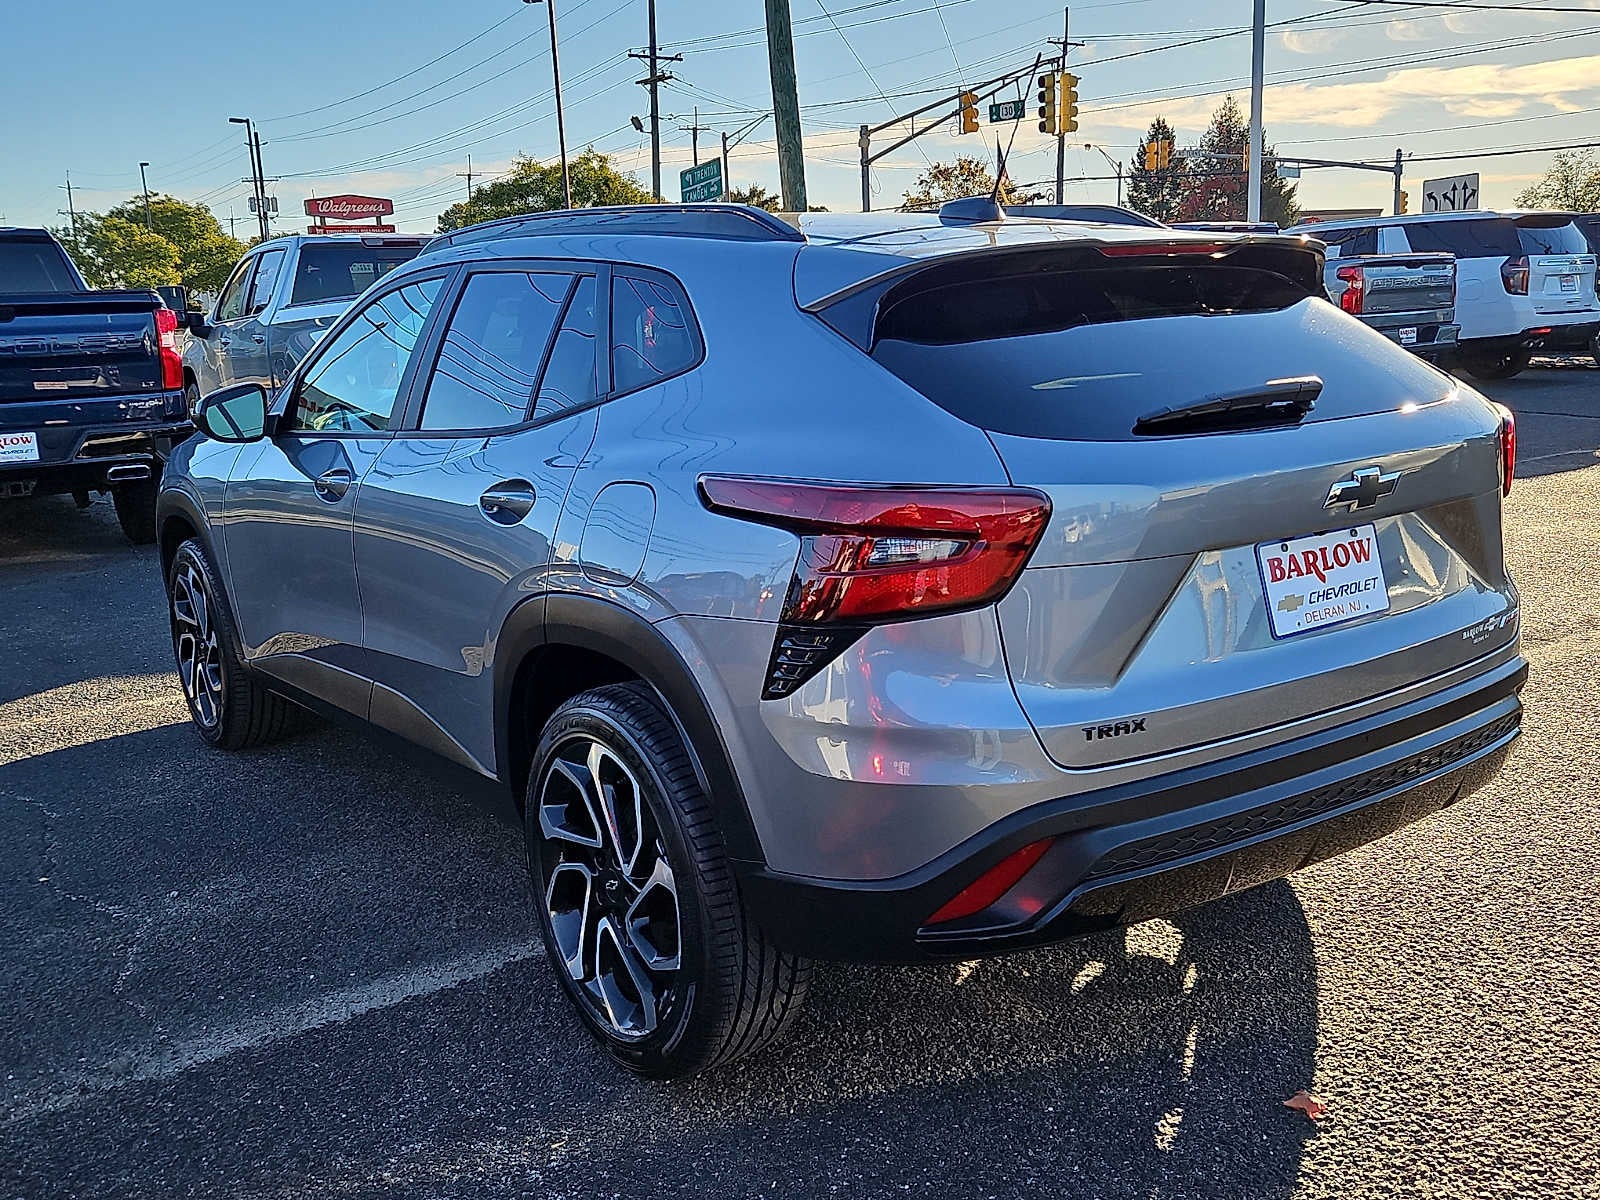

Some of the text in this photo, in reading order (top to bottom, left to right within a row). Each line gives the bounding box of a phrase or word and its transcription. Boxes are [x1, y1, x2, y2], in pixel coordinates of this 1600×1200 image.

[1002, 105, 1014, 117] 130
[316, 199, 386, 216] Walgreens
[1267, 538, 1371, 584] BARLOW
[1308, 577, 1378, 604] CHEVROLET
[1305, 600, 1361, 624] DELRAN, NJ
[1081, 717, 1147, 741] TRAX
